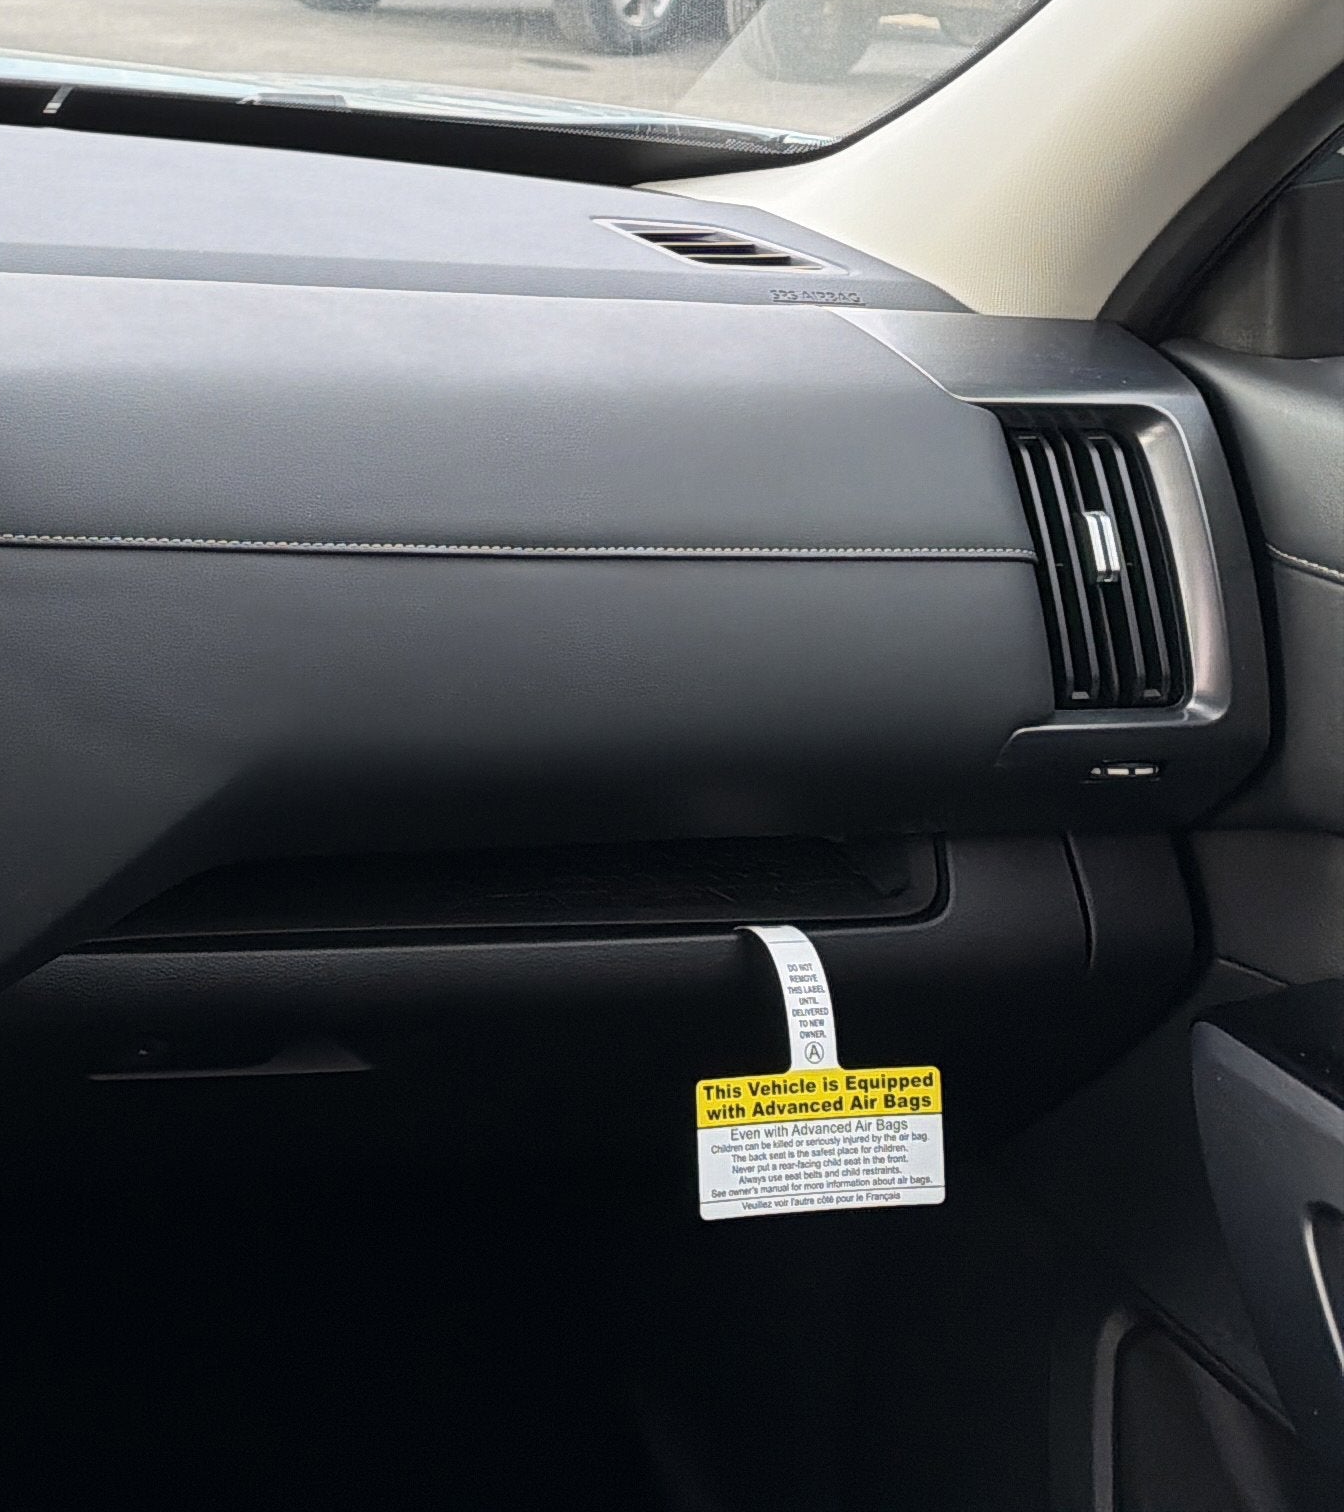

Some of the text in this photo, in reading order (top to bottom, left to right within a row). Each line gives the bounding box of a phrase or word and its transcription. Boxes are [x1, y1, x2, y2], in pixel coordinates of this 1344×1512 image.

[787, 963, 813, 972] DO NOT
[789, 974, 818, 983] REMOVE
[787, 985, 826, 994] THIS LABEL
[798, 996, 819, 1005] UNTIL
[792, 1007, 829, 1017] DELIVERED
[798, 1018, 825, 1027] TO NEW
[703, 1072, 934, 1101] This Vehicle is Equipped
[706, 1094, 932, 1121] with Advanced Air Bags
[731, 1118, 909, 1141] Even with Advanced Air Bags
[710, 1132, 909, 1154] Children can be killed seriously injured by the air
[732, 1154, 747, 1163] The
[748, 1152, 767, 1162] back
[769, 1151, 786, 1160] seat
[797, 1149, 810, 1158] the
[812, 1147, 835, 1157] safest
[837, 1146, 859, 1157] place
[860, 1145, 871, 1154] for
[732, 1165, 755, 1174] Never
[757, 1163, 770, 1173] put
[778, 1159, 821, 1170] rear-facing
[822, 1158, 842, 1167] child
[843, 1157, 861, 1166] seat
[872, 1155, 885, 1164] the
[738, 1175, 766, 1185] Always
[768, 1174, 783, 1182] use
[803, 1170, 822, 1179] belts
[824, 1169, 839, 1177] and
[841, 1167, 861, 1176] child
[711, 1189, 726, 1198] See
[728, 1186, 759, 1196] owner's
[760, 1184, 790, 1194] manual
[826, 1178, 870, 1189] information
[872, 1177, 895, 1186] about
[897, 1176, 908, 1185] air
[741, 1201, 772, 1210] Veuillez
[774, 1198, 789, 1208] voir
[836, 1194, 854, 1205] pour
[865, 1191, 901, 1202] Français
